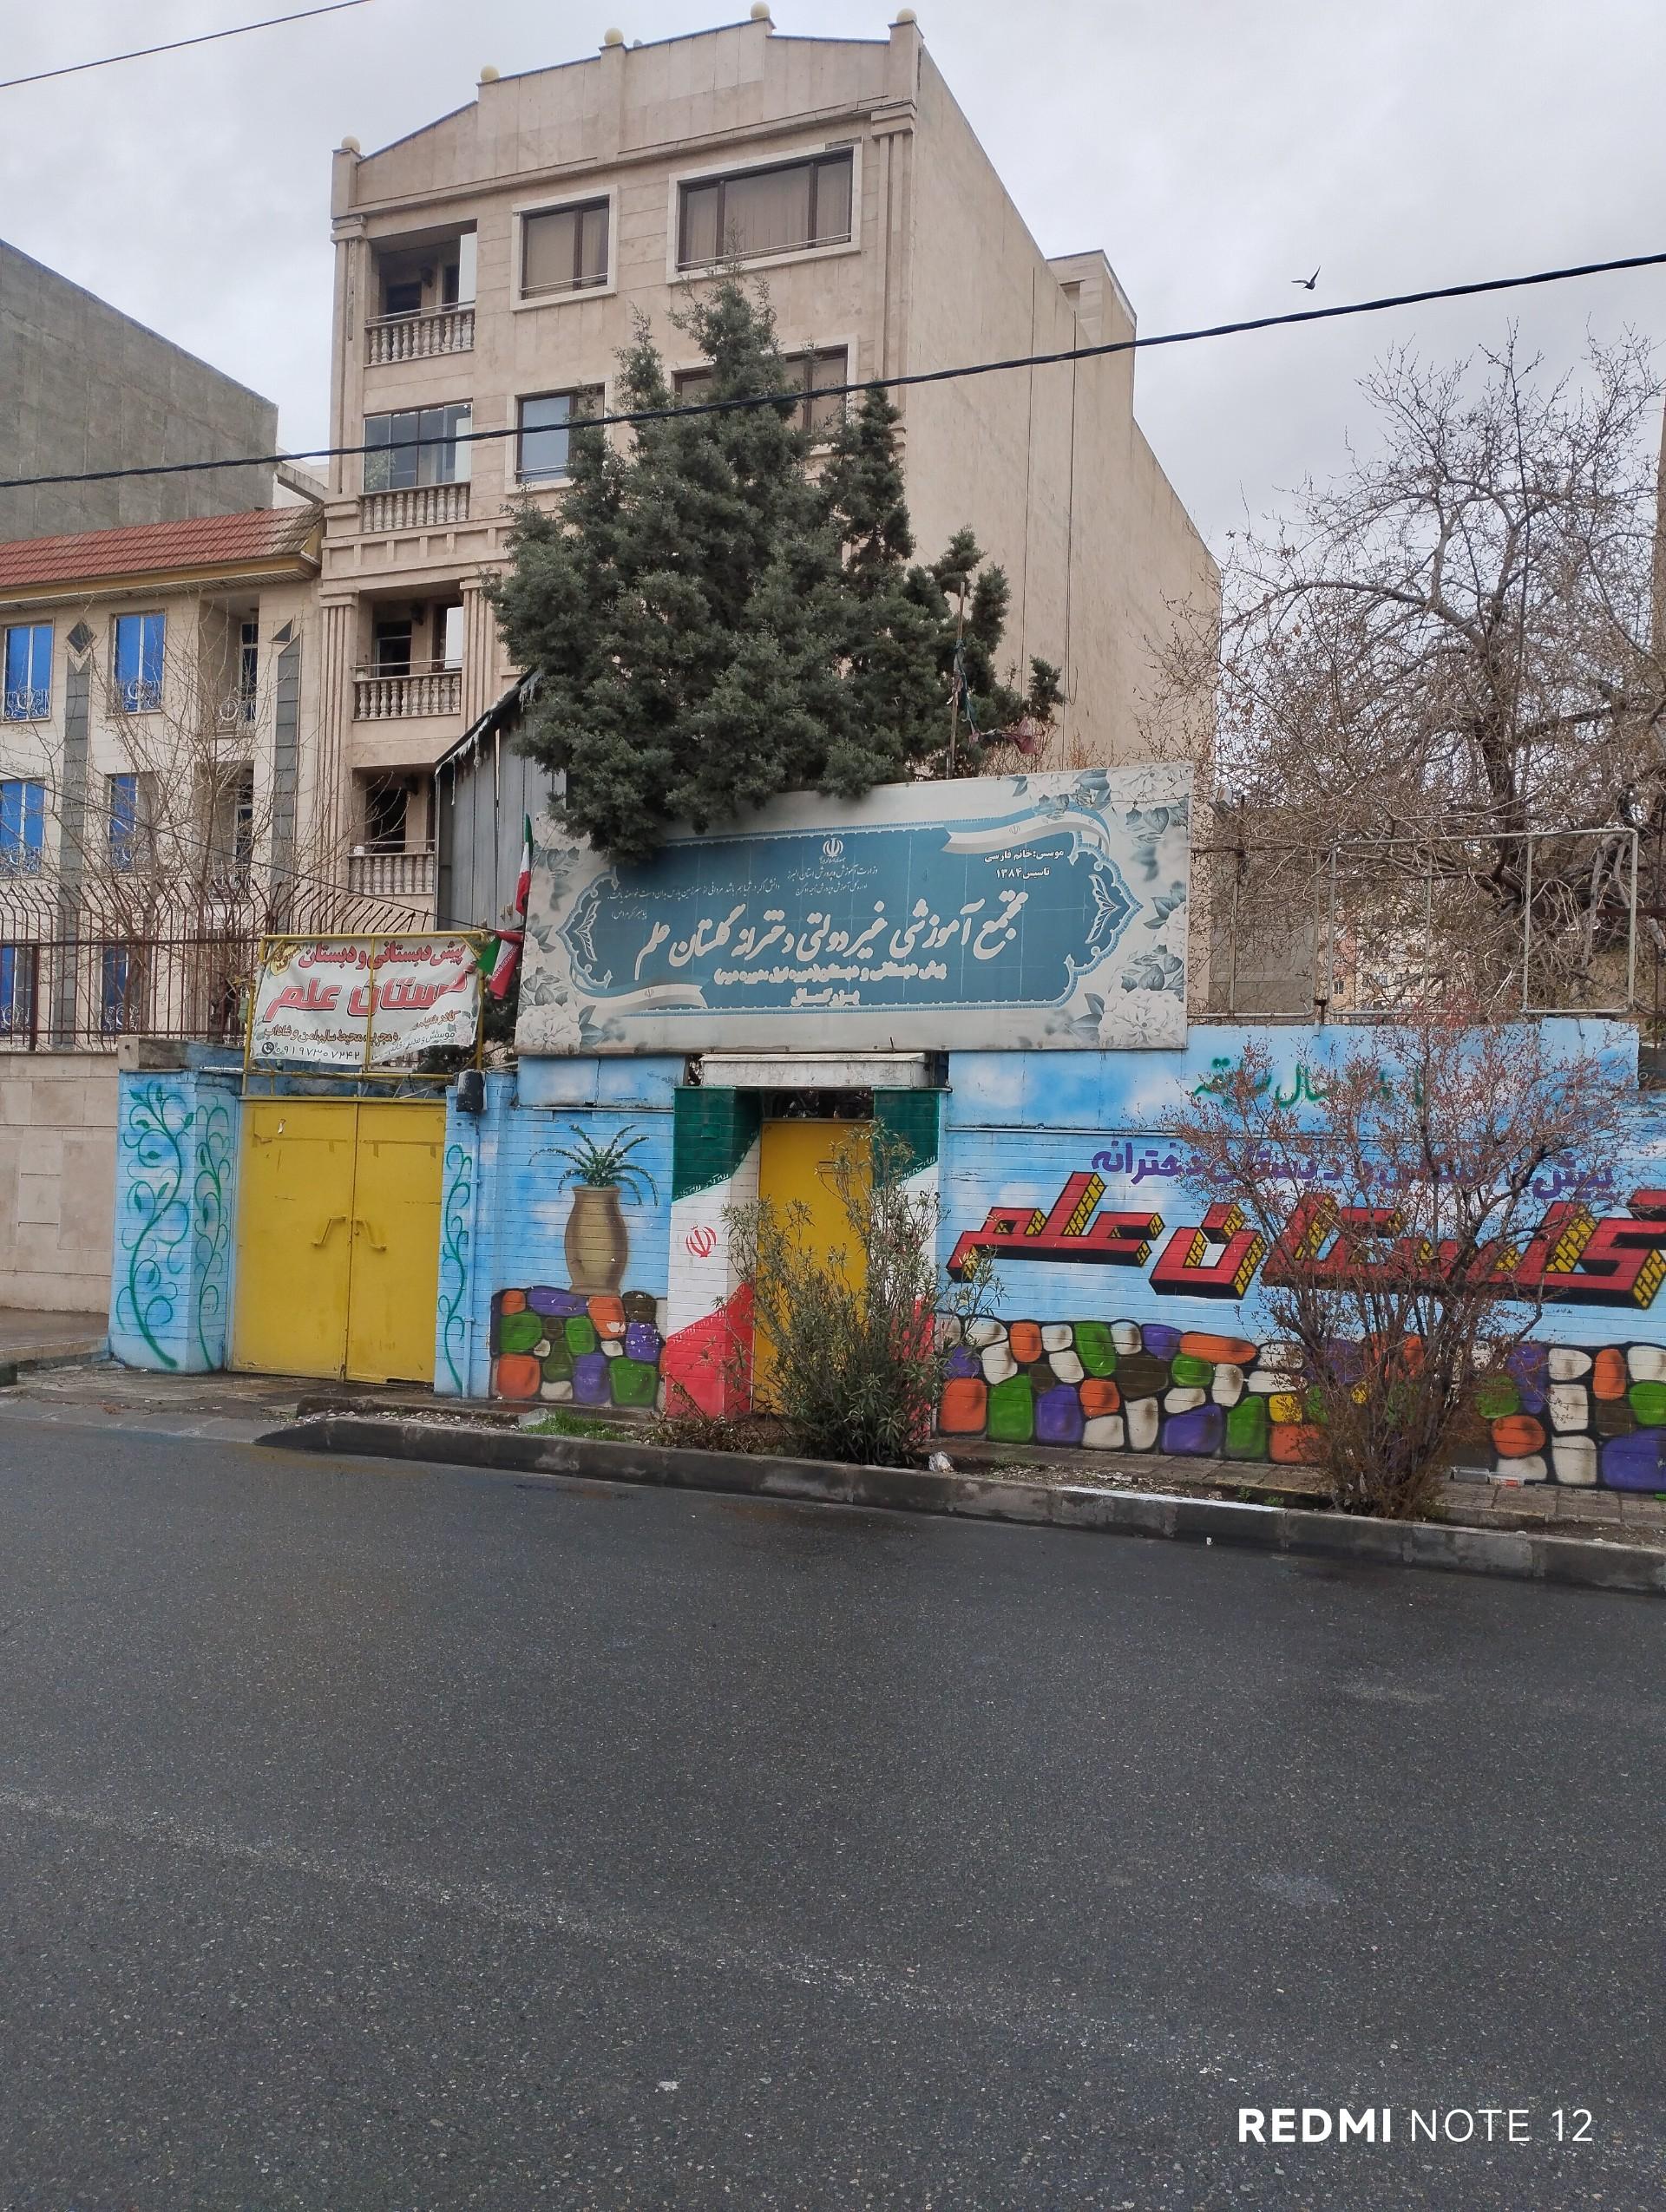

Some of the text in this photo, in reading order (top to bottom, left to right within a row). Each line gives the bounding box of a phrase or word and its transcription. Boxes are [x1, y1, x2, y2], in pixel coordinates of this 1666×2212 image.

[984, 850, 1012, 864] فارسی
[995, 867, 1022, 879] ۱۳۸۴
[731, 909, 796, 961] دخترانه
[889, 898, 986, 959] آموزشی
[973, 889, 1029, 960] مجتمع
[298, 939, 357, 970] دبستان
[355, 949, 367, 971] و
[366, 939, 433, 971] دبستانی
[430, 940, 467, 966] پیش
[634, 921, 671, 981] علم
[262, 978, 343, 1024] علم
[263, 1024, 292, 1040] شاداب
[946, 1171, 1166, 1283] علم
